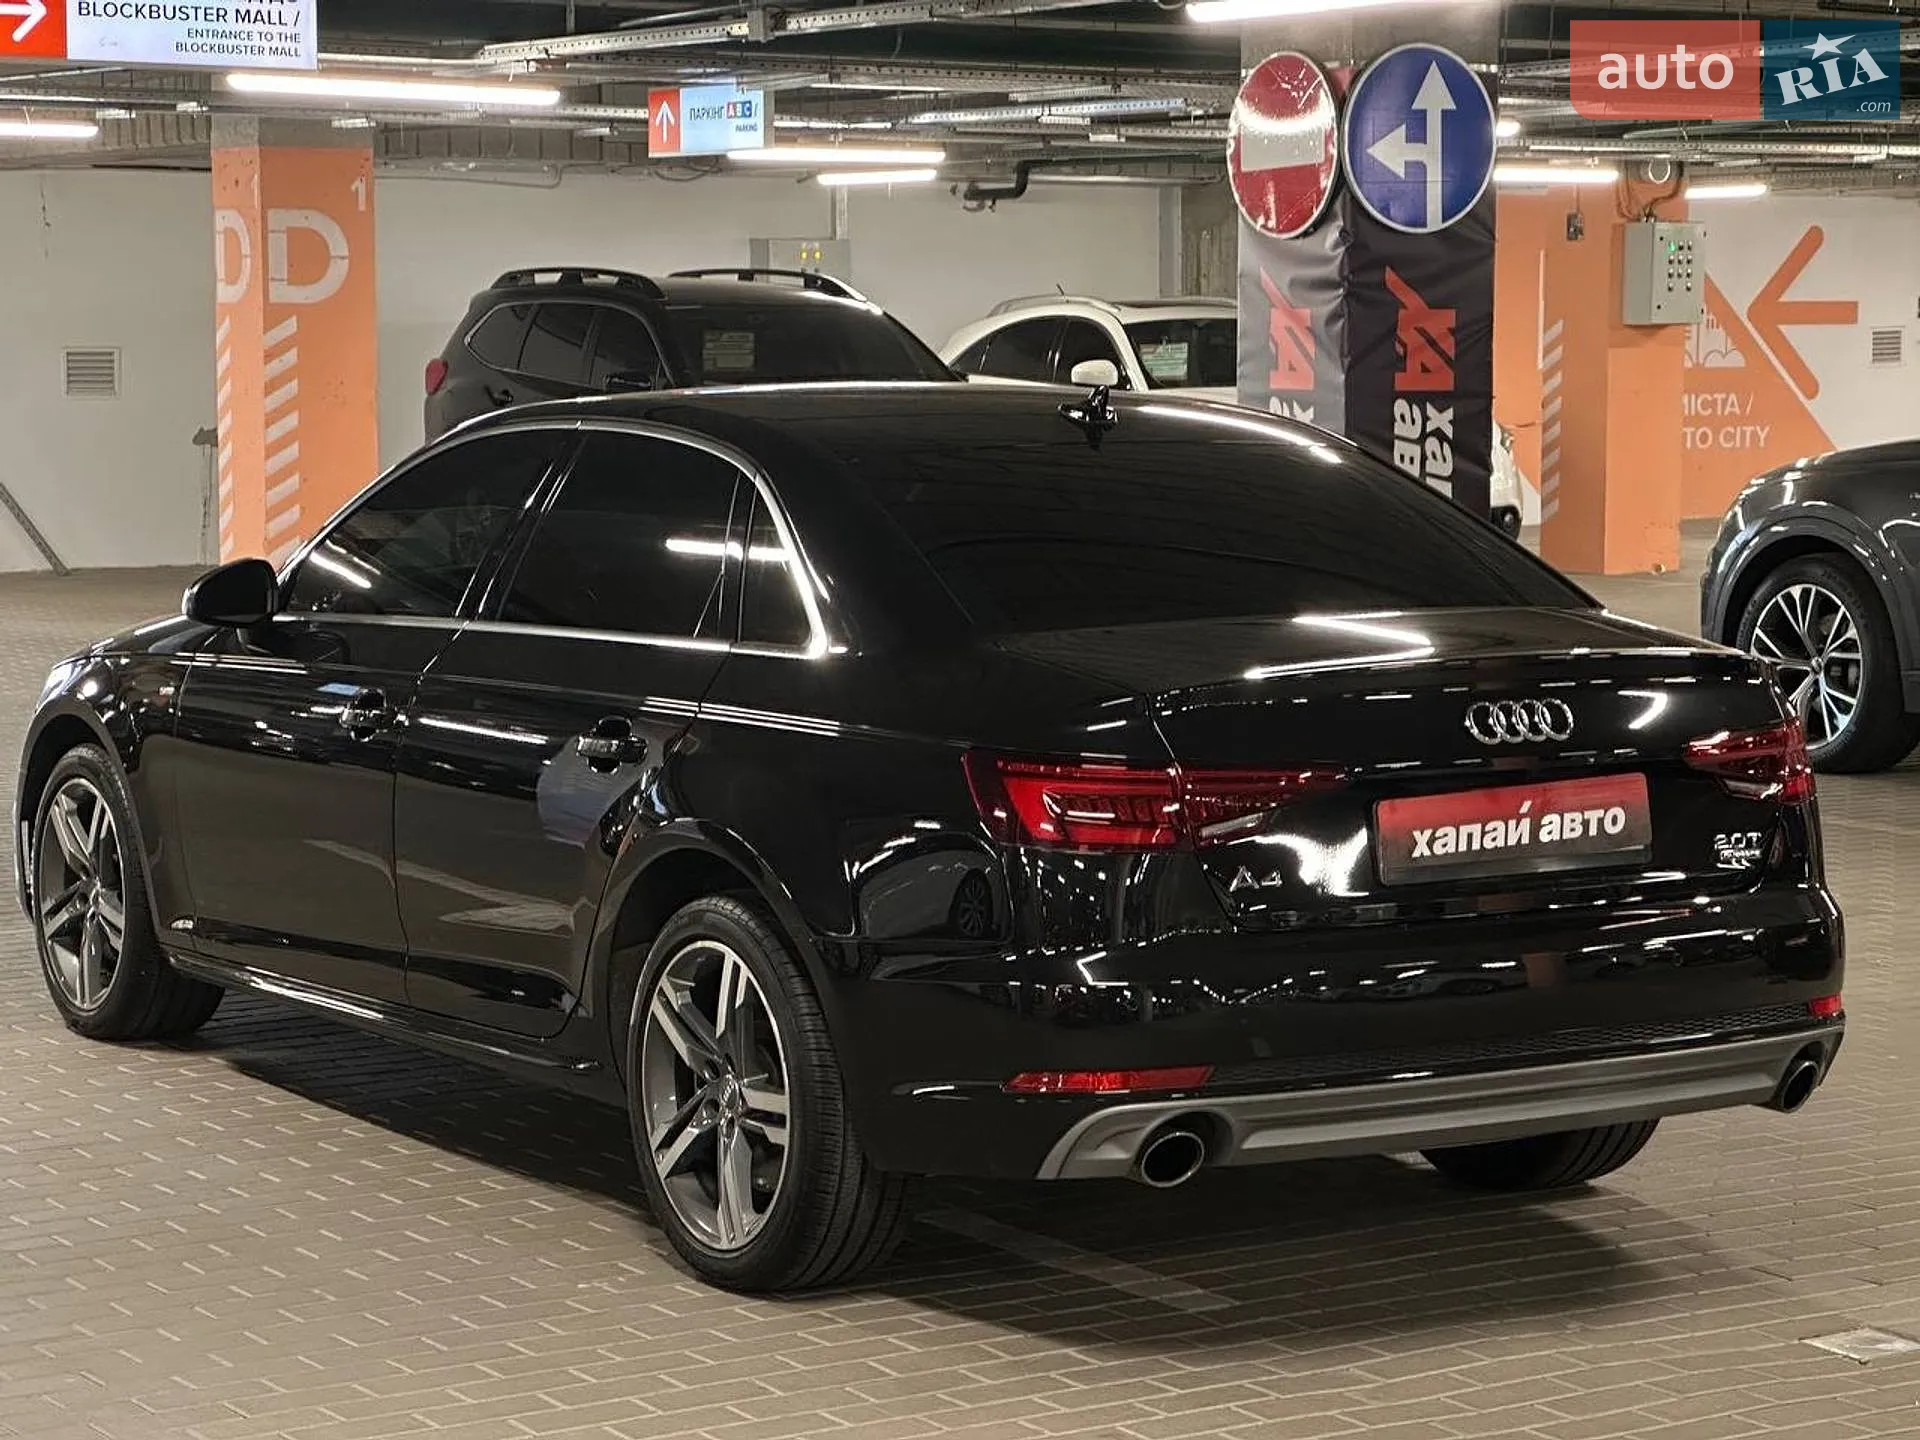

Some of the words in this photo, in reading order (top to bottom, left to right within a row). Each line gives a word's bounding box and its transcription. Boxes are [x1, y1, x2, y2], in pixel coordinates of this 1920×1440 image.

[78, 1, 229, 23] BLOCKBUSTER
[235, 8, 288, 26] MALL
[187, 27, 254, 42] ENTRANCE
[257, 31, 274, 42] TO
[277, 32, 301, 43] THE
[175, 42, 265, 56] BLOCKBUSTER
[269, 46, 301, 57] MALL
[351, 177, 367, 212] 1
[215, 208, 251, 304] D
[267, 208, 349, 304] D
[1682, 426, 1713, 449] TO
[1719, 424, 1770, 448] CITY
[1538, 806, 1626, 843] авто
[1229, 865, 1283, 893] A4
